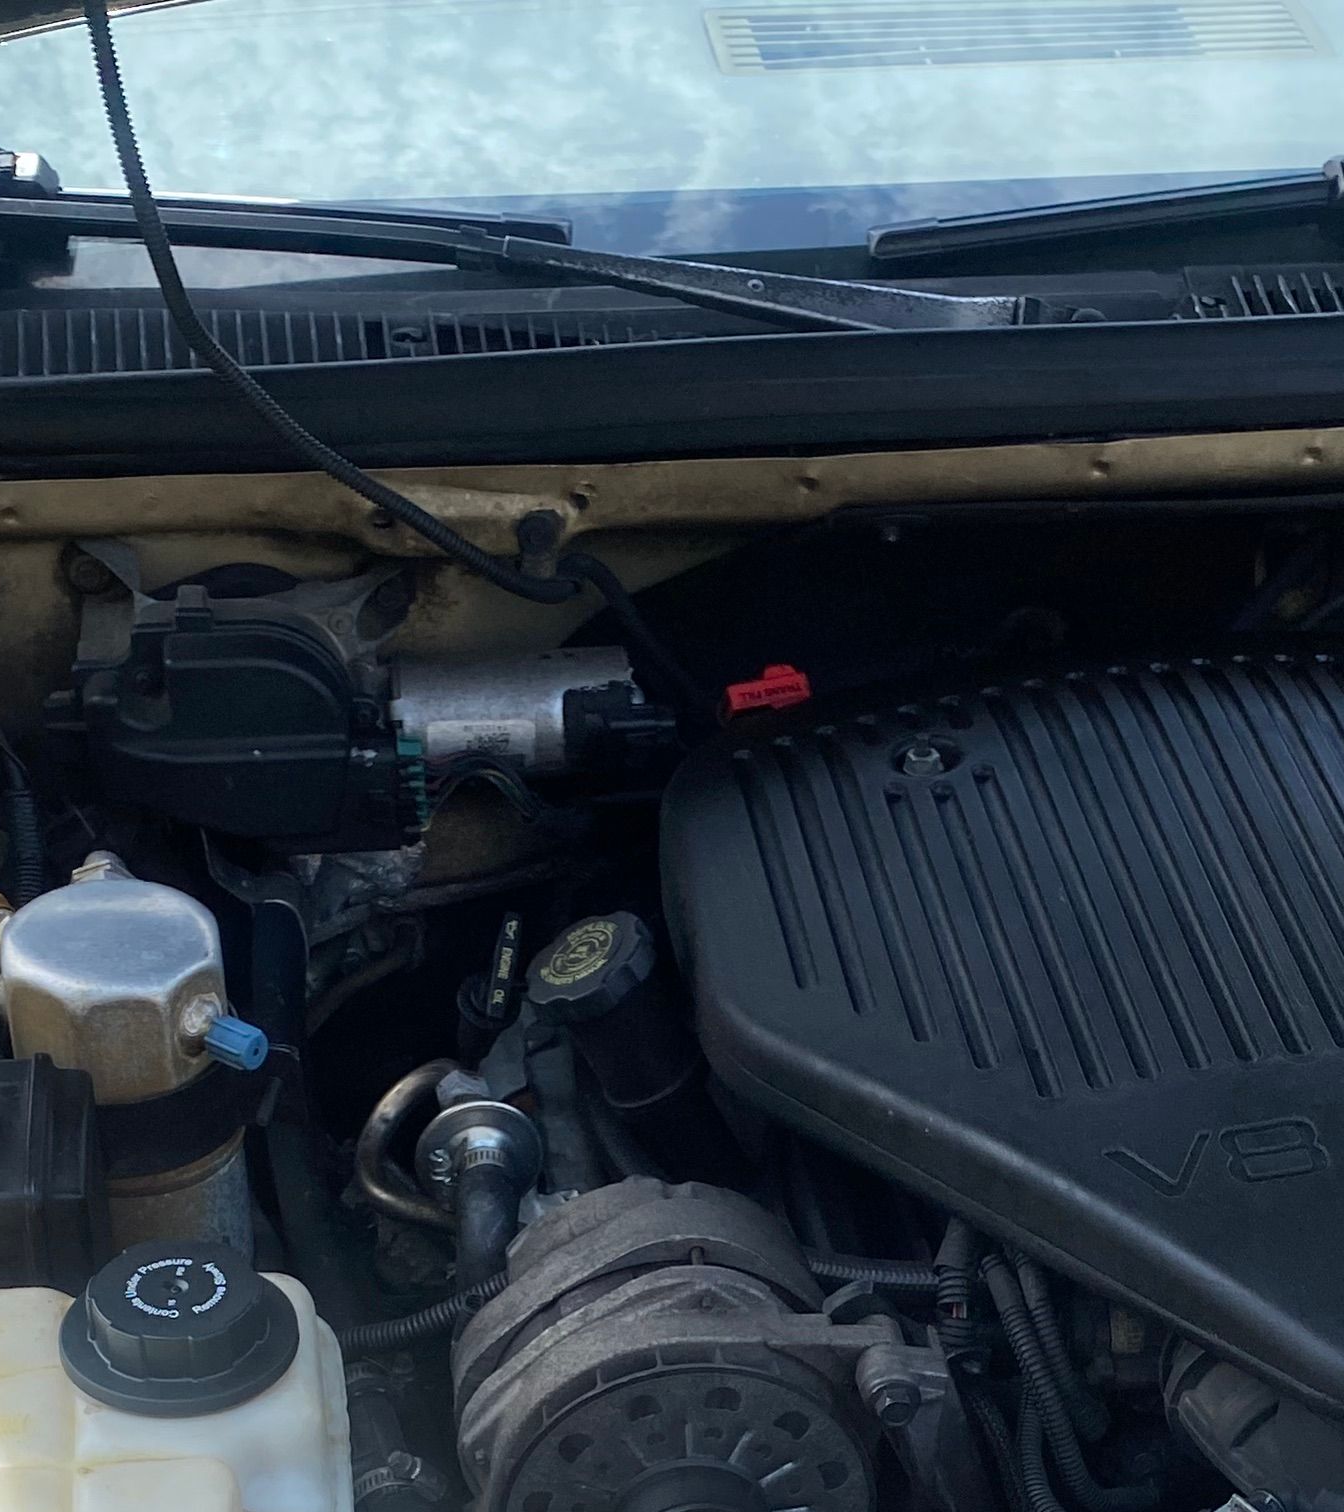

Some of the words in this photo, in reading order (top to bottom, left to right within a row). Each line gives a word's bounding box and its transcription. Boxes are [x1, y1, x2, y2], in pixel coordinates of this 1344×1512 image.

[498, 947, 513, 979] ENGINE
[493, 989, 504, 1004] OIL
[1102, 1116, 1330, 1198] V8
[137, 1259, 192, 1274] Pressure
[202, 1262, 226, 1285] Slowly
[124, 1273, 142, 1299] Under
[131, 1298, 179, 1318] Contents
[192, 1286, 226, 1314] Remove
